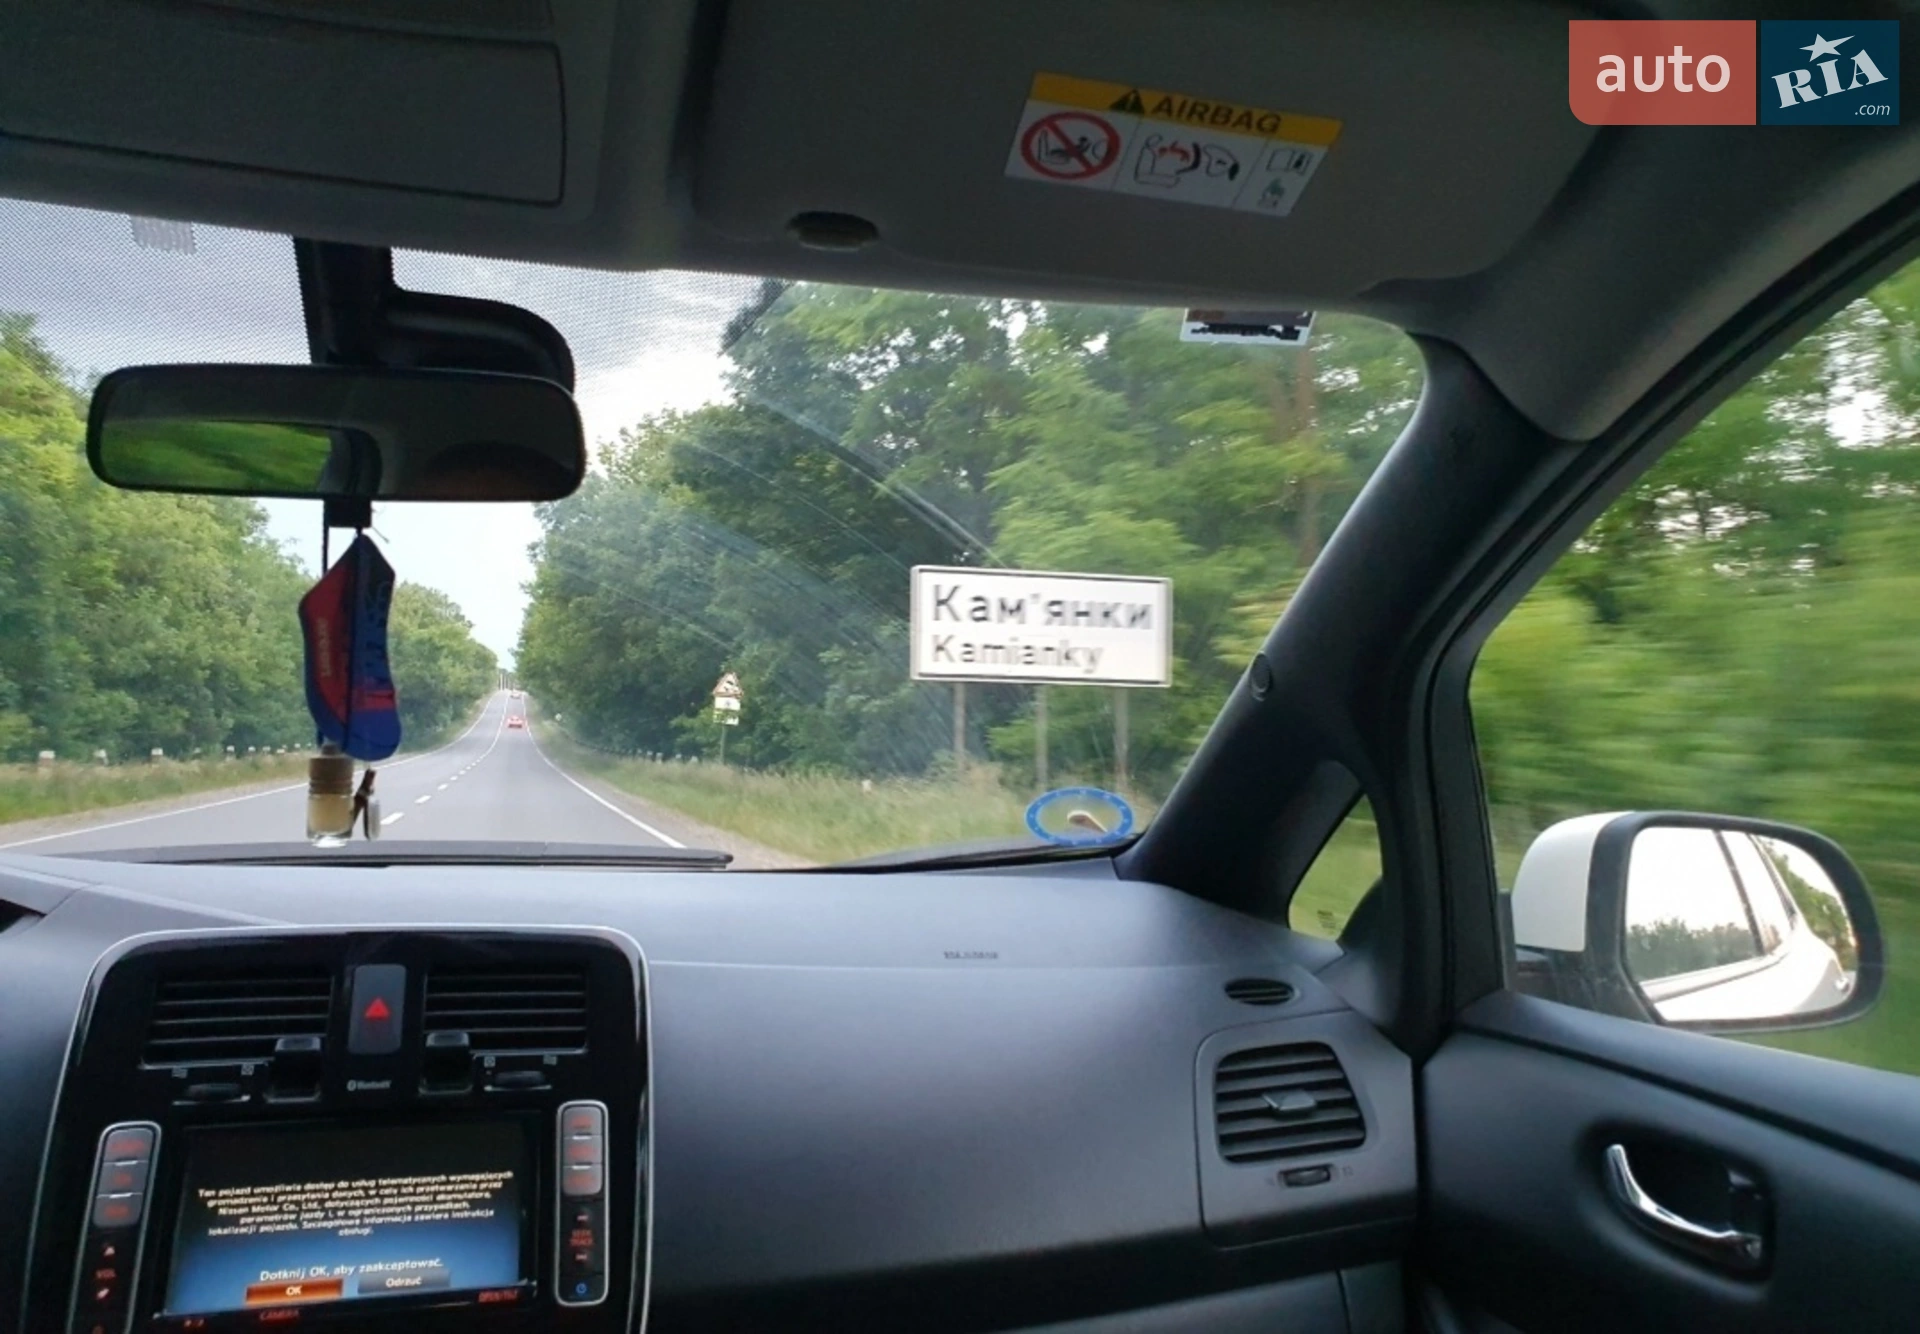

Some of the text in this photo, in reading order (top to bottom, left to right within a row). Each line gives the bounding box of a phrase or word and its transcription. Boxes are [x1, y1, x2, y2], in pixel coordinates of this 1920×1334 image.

[1151, 95, 1283, 134] AIRBAG
[931, 584, 1155, 630] Кам'янки
[931, 634, 1106, 674] Kamianky
[207, 1196, 268, 1208] gromadzenia
[402, 1186, 414, 1194] ich
[479, 1180, 503, 1190] przez
[218, 1187, 252, 1198] pojazd
[337, 1180, 350, 1188] do
[378, 1174, 447, 1186] telematycznych
[449, 1170, 514, 1183] wymagających
[218, 1206, 249, 1216] Nissan
[251, 1204, 279, 1213] Motor
[239, 1213, 297, 1225] parametrów
[300, 1211, 326, 1222] jazdy
[348, 1204, 412, 1217] ograniczonych
[208, 1224, 257, 1236] lokalizacji
[414, 1212, 450, 1222] zawiera
[260, 1257, 444, 1281] Dotknij OK, aby zaakceptować.
[285, 1285, 302, 1296] OK
[385, 1275, 422, 1288] Odrzuć
